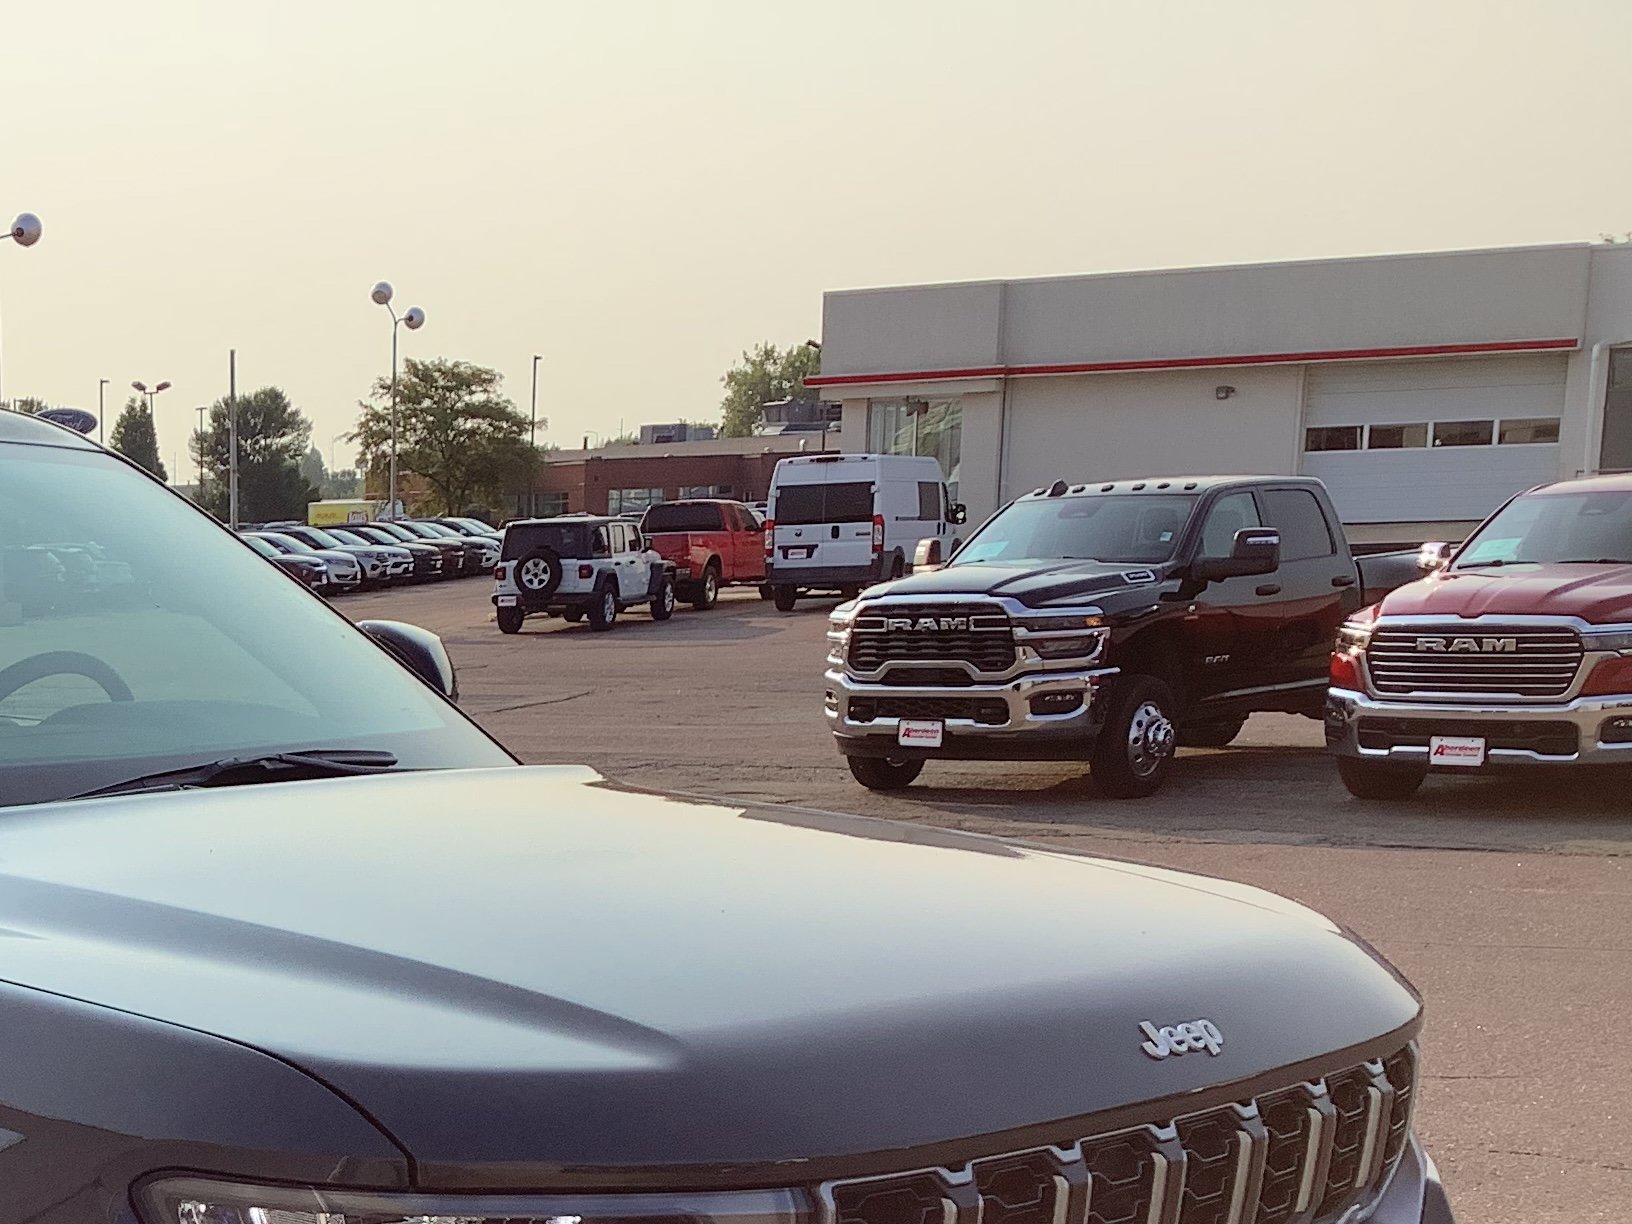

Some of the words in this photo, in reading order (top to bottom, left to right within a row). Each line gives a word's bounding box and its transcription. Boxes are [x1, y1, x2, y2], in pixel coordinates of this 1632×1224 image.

[887, 617, 968, 631] RAM
[1416, 637, 1517, 652] RAM
[1138, 1019, 1224, 1058] Jeep
